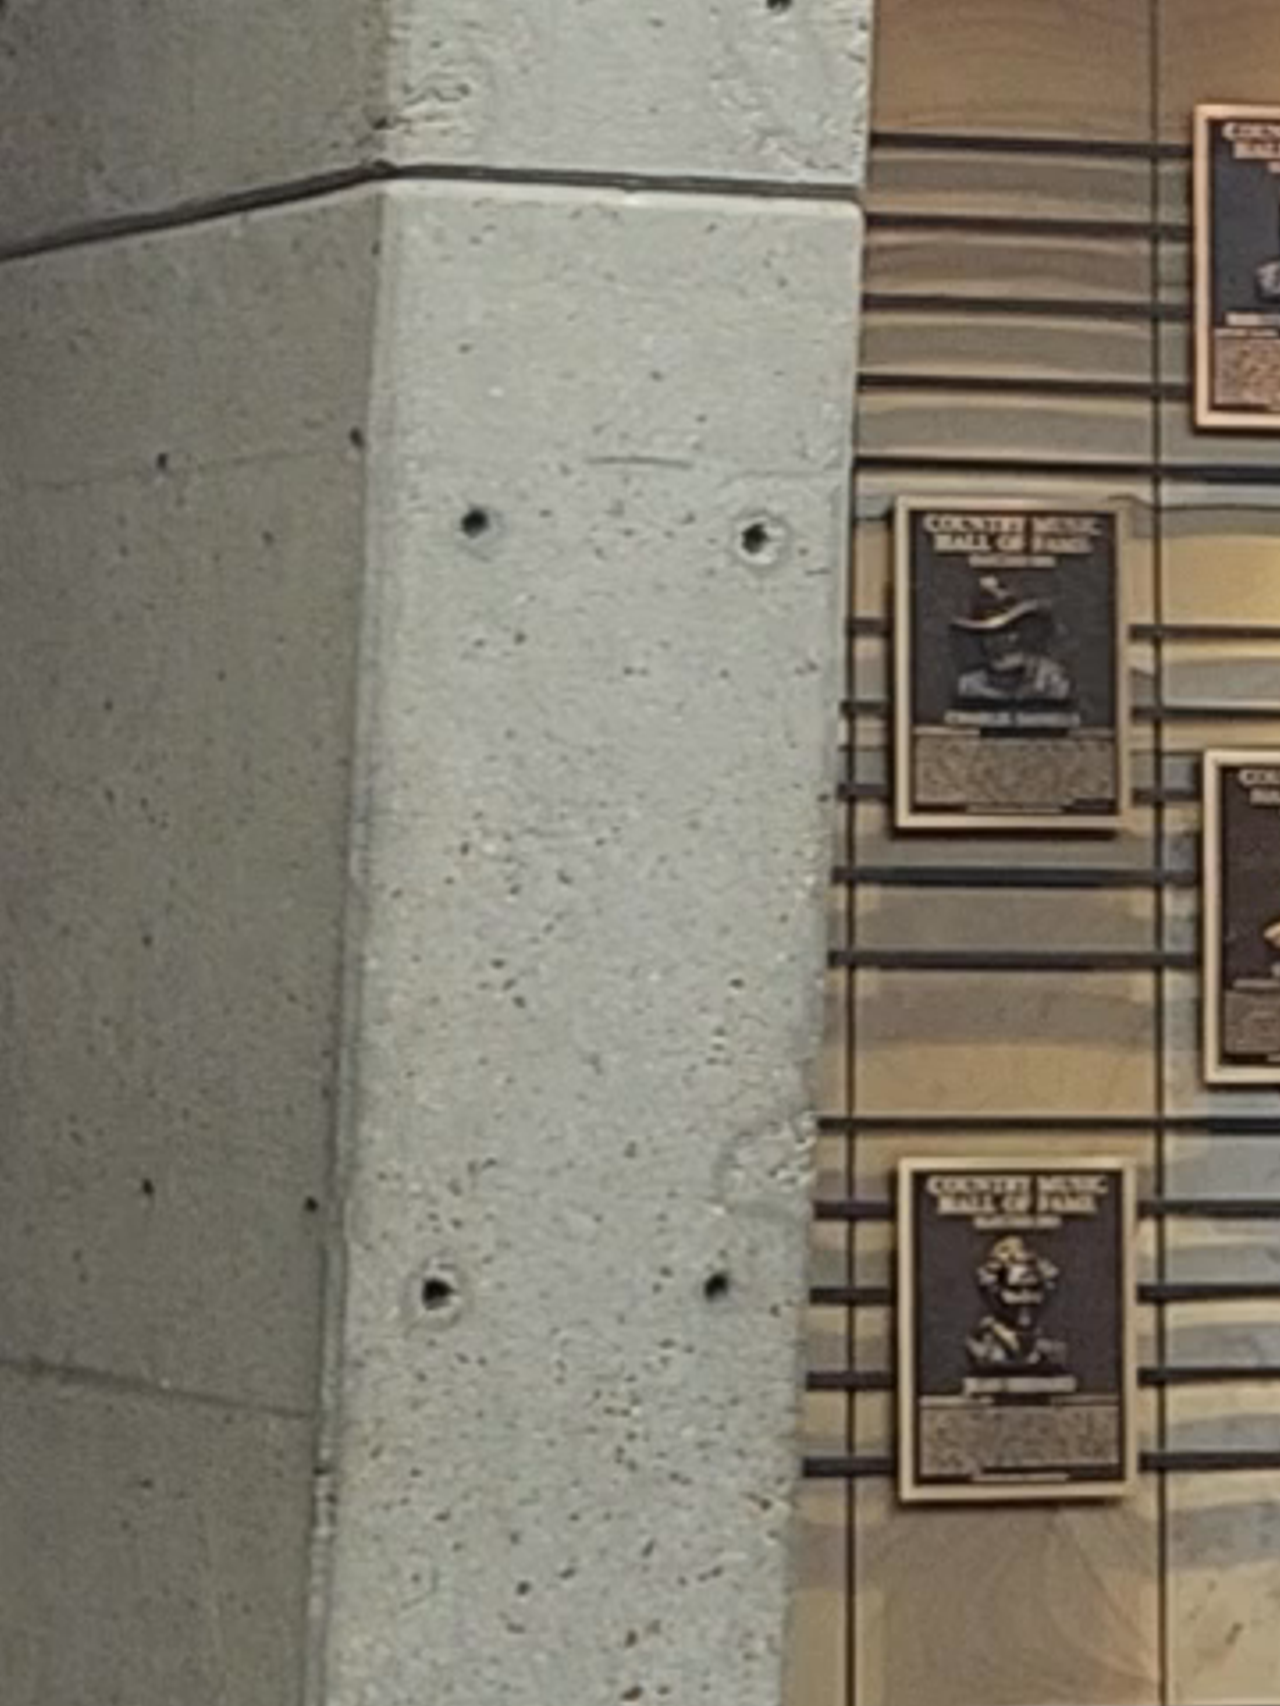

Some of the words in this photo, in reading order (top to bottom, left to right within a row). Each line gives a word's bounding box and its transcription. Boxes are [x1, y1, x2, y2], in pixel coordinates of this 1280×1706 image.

[923, 512, 1026, 534] COUNTRY
[1032, 515, 1104, 536] MUSIC
[934, 532, 992, 552] HALL
[995, 534, 1025, 553] OF
[1031, 534, 1093, 554] FAME
[926, 1174, 1032, 1195] COUNTRY
[1036, 1175, 1109, 1195] MUSIC
[937, 1193, 996, 1215] HALL
[1000, 1194, 1031, 1214] OF
[1036, 1193, 1098, 1214] FAME
